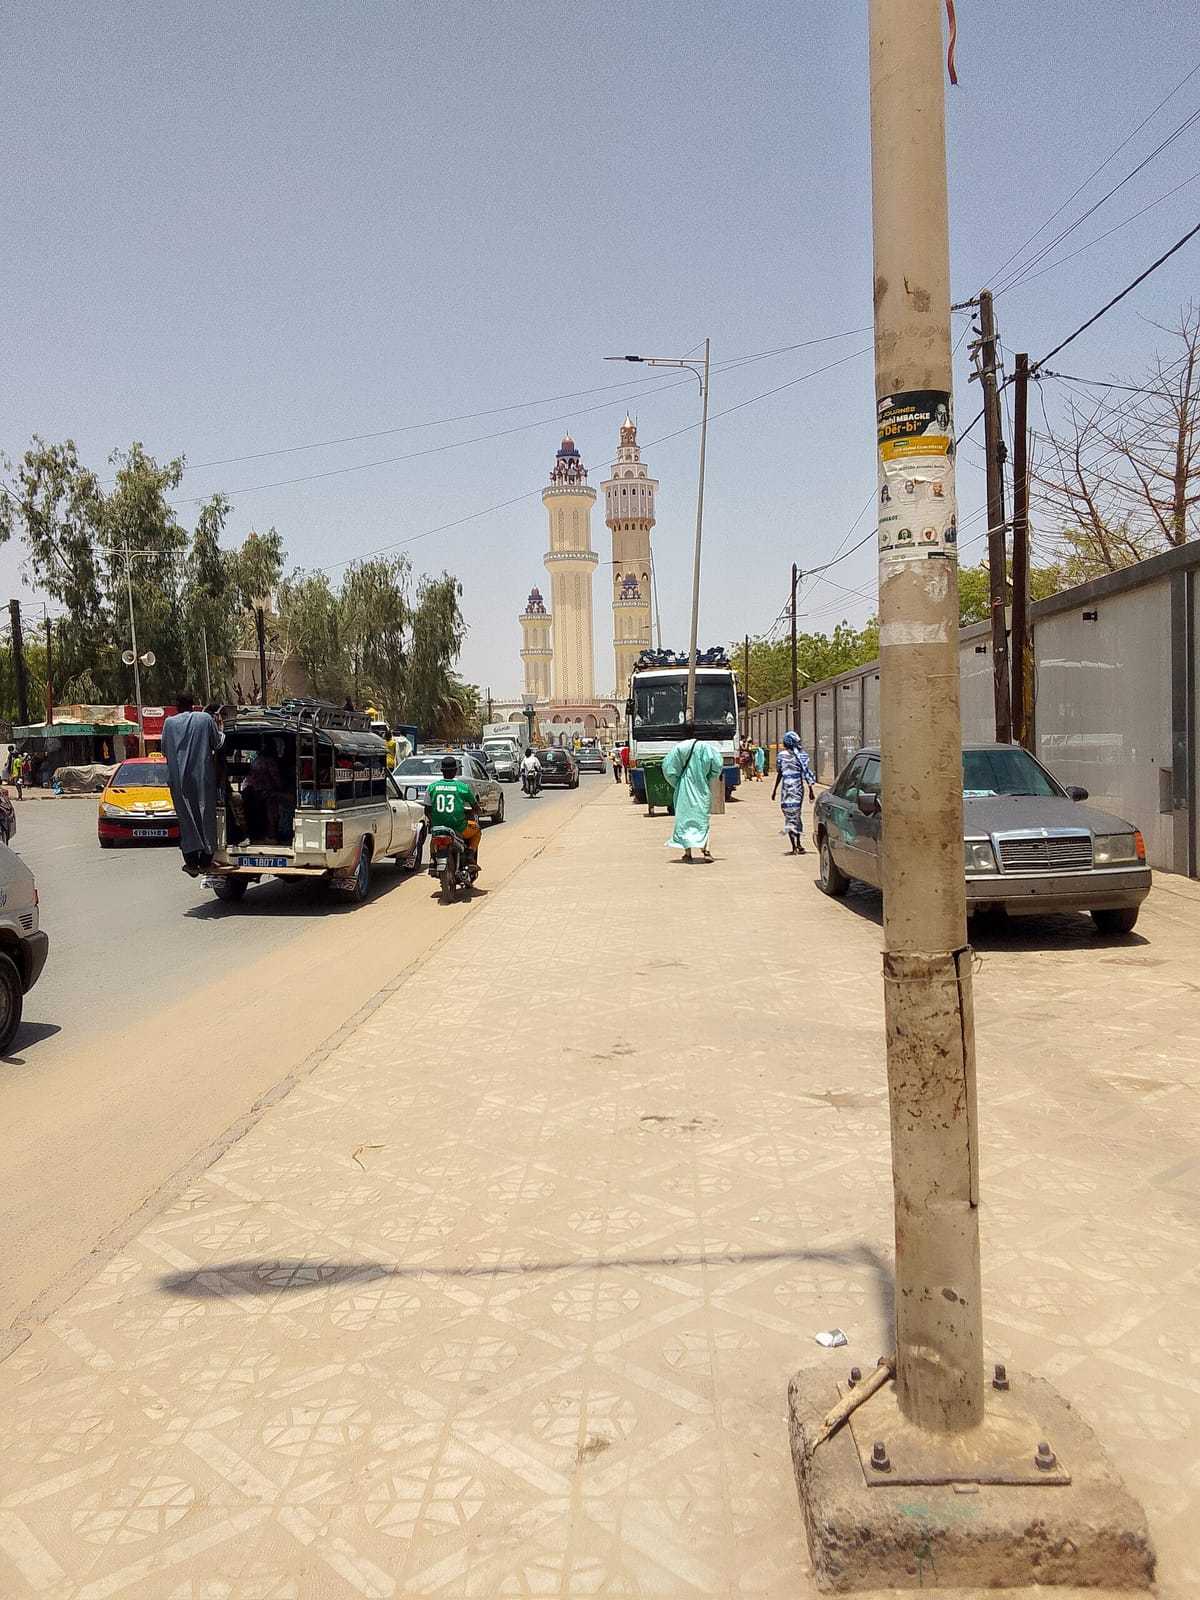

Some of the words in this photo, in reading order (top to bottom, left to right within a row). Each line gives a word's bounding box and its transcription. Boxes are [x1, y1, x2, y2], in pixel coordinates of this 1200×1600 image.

[896, 412, 931, 422] MBACKE
[436, 794, 455, 813] 03
[255, 858, 274, 867] 1807
